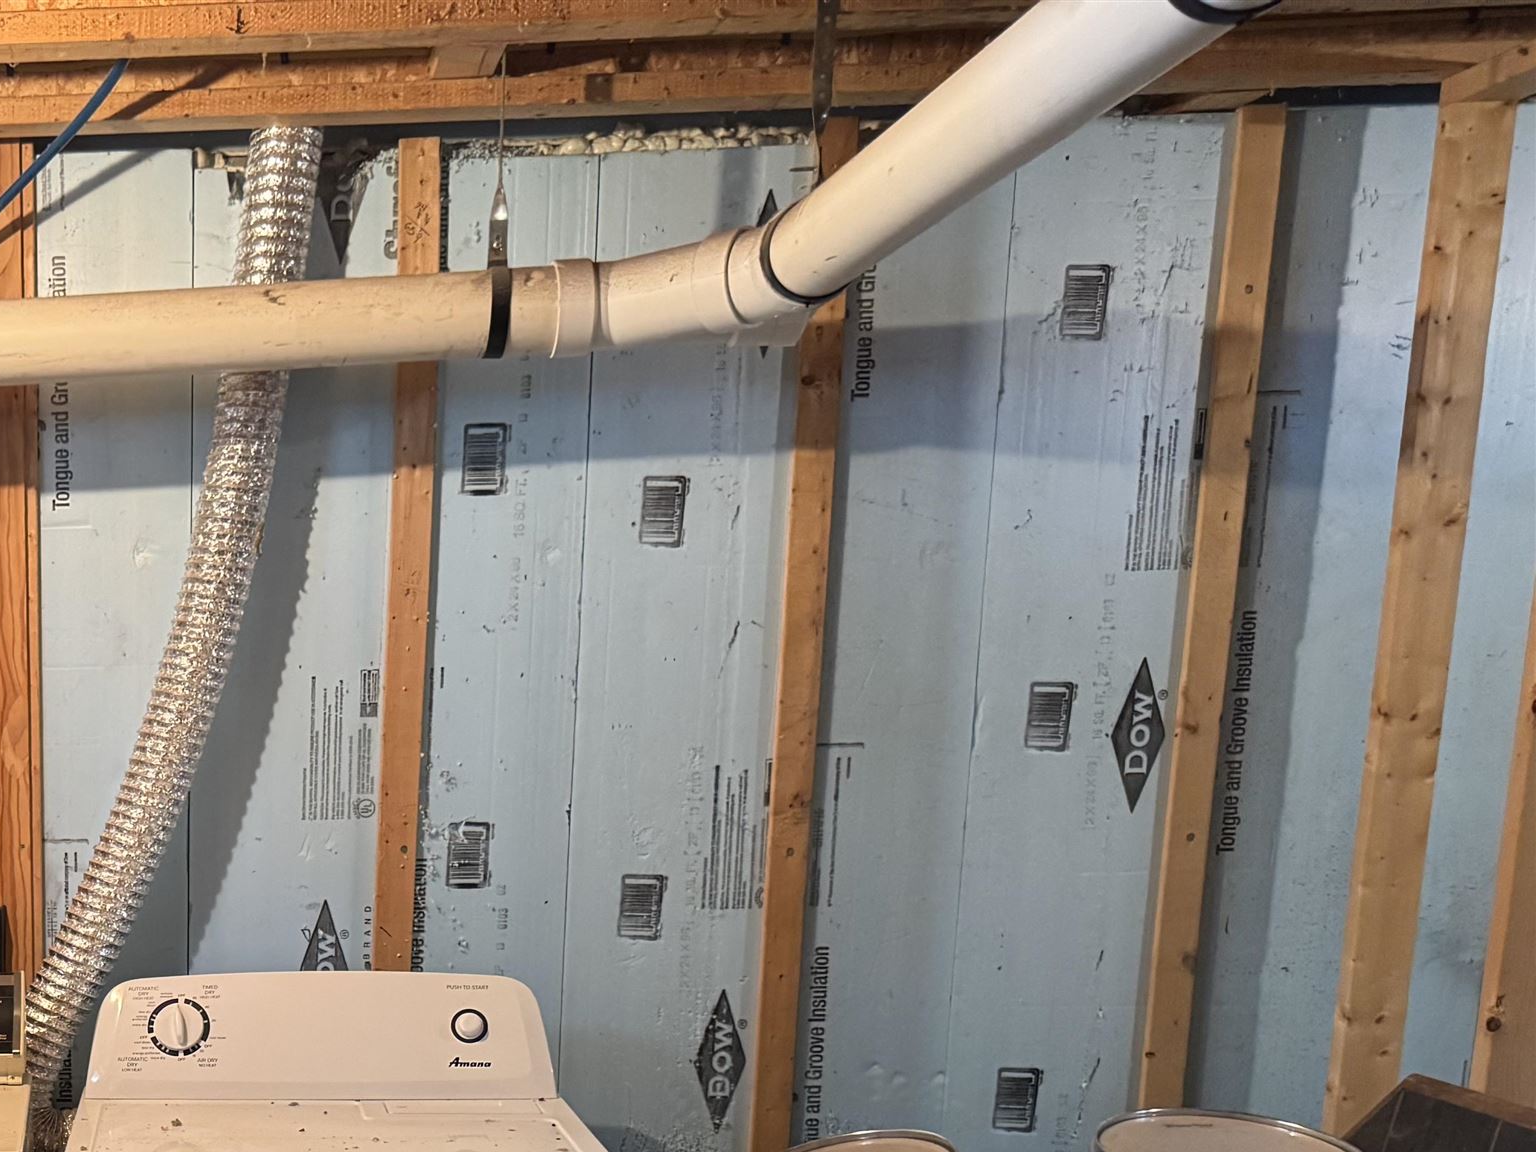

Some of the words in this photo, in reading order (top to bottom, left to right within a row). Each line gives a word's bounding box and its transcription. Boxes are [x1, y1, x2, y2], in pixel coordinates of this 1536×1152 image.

[48, 255, 68, 297] ation
[856, 299, 875, 332] and
[850, 337, 875, 402] Tongue
[51, 410, 70, 441] and
[51, 449, 73, 512] Tongue
[1232, 610, 1257, 692] Insulation
[1123, 688, 1154, 776] DOW
[1226, 697, 1249, 755] Groove
[1225, 760, 1243, 791] and
[1216, 796, 1240, 856] Tongue
[317, 929, 337, 971] OW
[362, 905, 373, 961] BRAND
[808, 946, 830, 1022] Insulation
[448, 1056, 492, 1068] Amana
[707, 1019, 733, 1097] DOW
[804, 1026, 826, 1080] Groove
[804, 1085, 822, 1114] and
